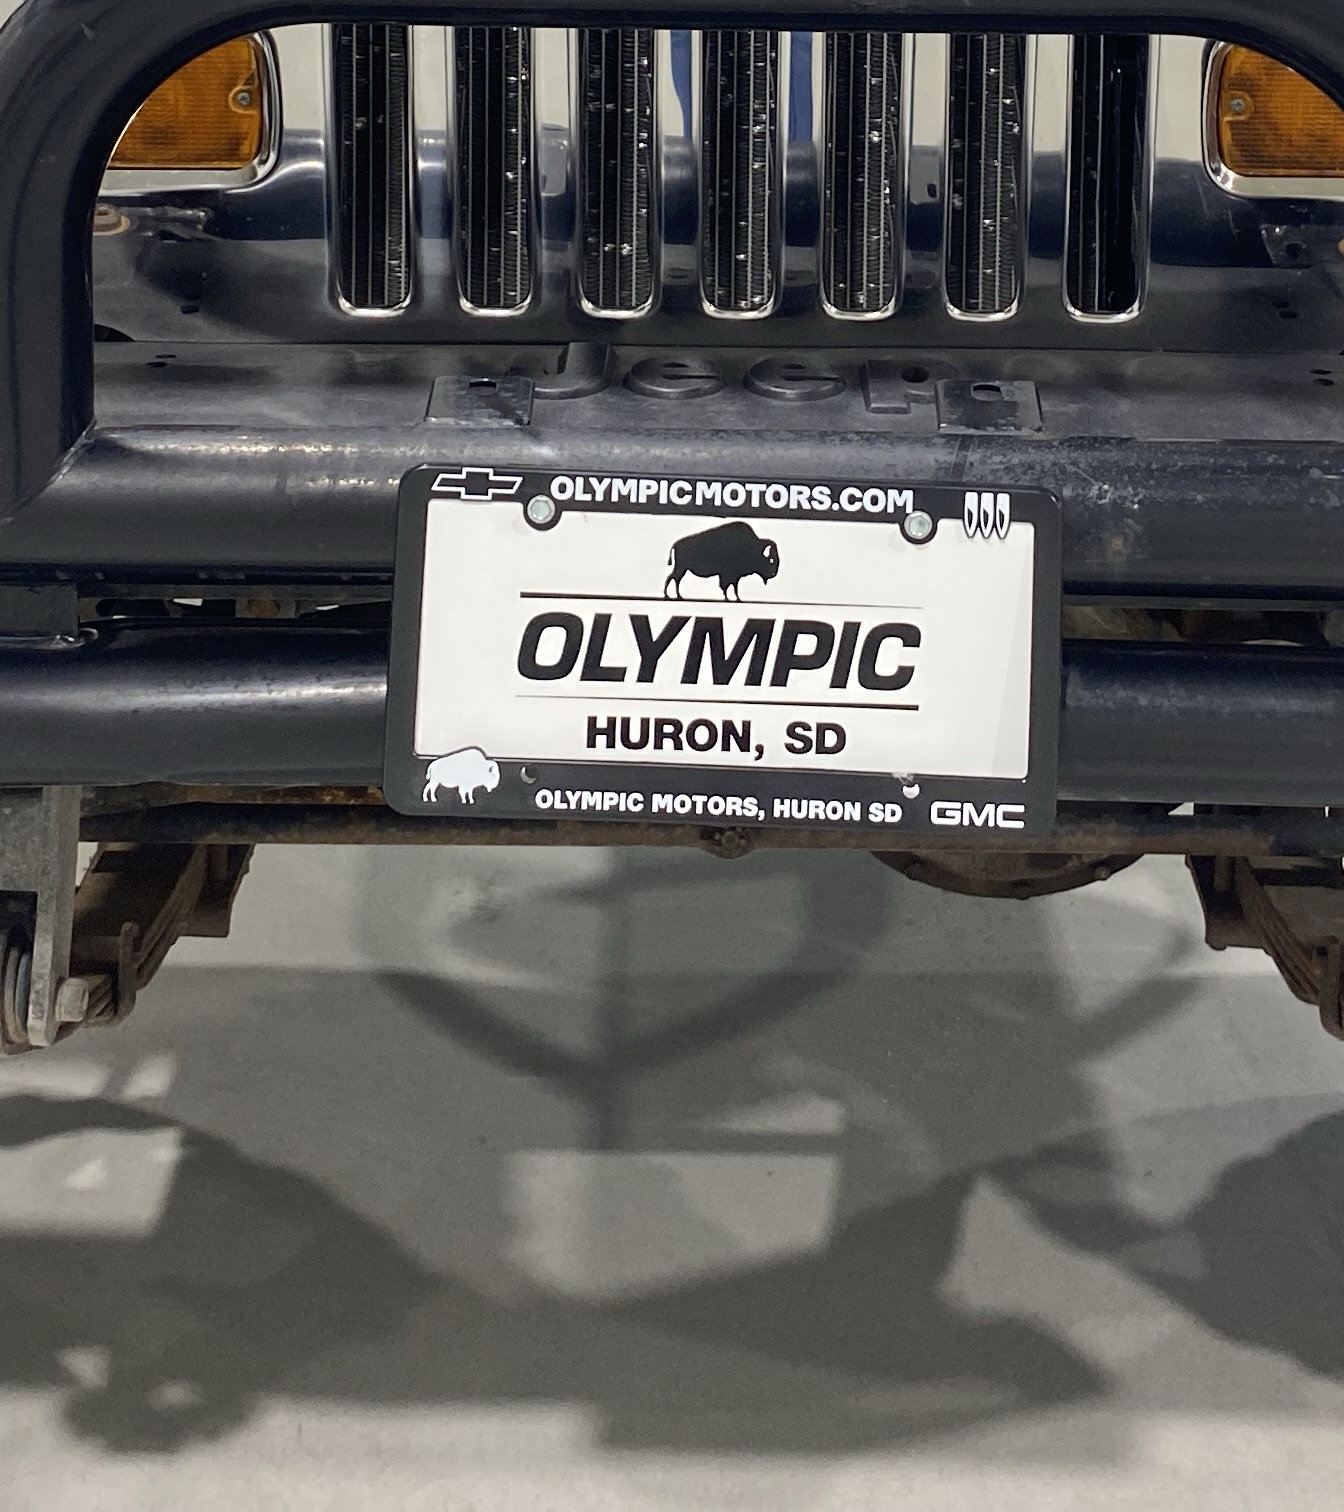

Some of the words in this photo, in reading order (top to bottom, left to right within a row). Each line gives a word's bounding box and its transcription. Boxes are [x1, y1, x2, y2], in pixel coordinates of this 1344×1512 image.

[549, 475, 914, 514] OLYMPICMOTORS.COM
[516, 612, 922, 692] OLYMPIC
[586, 715, 765, 762] HURON,
[784, 721, 847, 757] SD
[535, 789, 643, 814] OLYMPIC
[650, 792, 765, 821] MOTORS,
[773, 798, 861, 822] HURON
[868, 803, 903, 824] SD
[930, 801, 1026, 830] GMC
